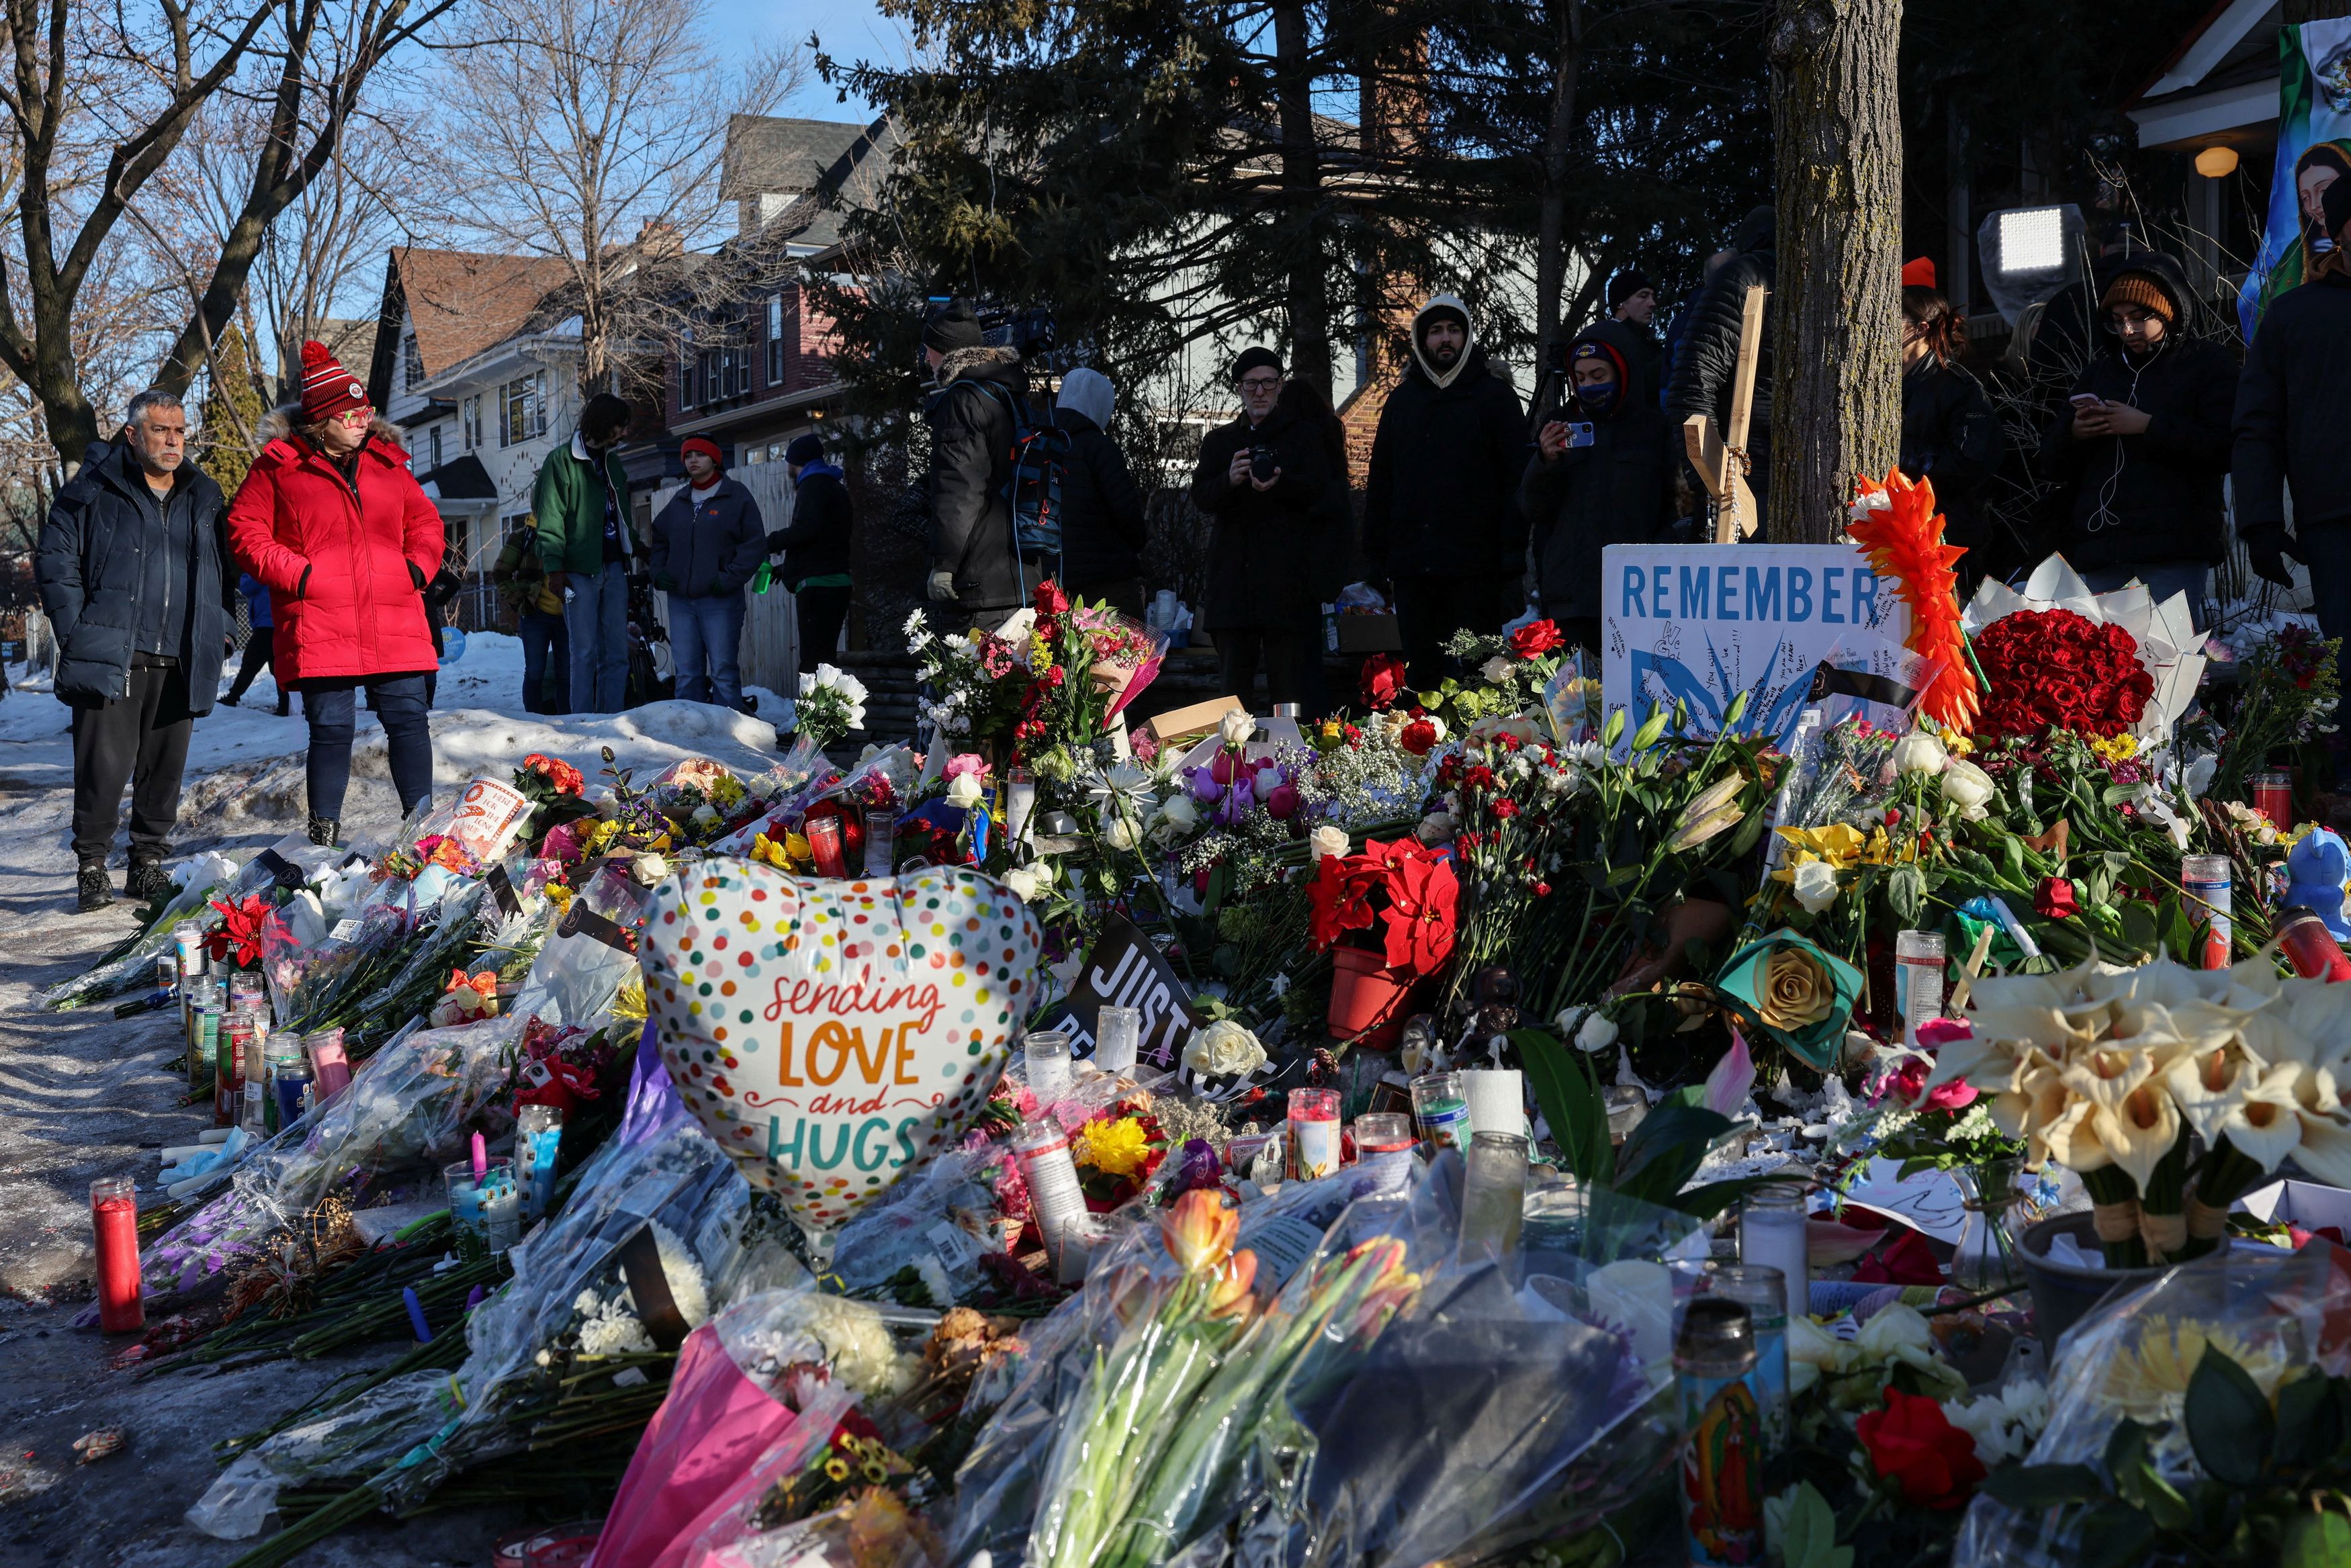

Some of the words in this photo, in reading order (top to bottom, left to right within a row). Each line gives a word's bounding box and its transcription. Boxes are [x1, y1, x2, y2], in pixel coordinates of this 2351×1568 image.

[1622, 565, 1879, 625] REMEMBER
[1607, 616, 1617, 631] REST
[1615, 630, 1625, 643] EASY
[1662, 620, 1681, 649] We
[1722, 647, 1728, 658] be
[1768, 686, 1777, 702] will
[1689, 702, 1703, 716] YOU
[1708, 710, 1724, 721] WI
[1746, 698, 1756, 714] will
[1687, 714, 1695, 727] BE
[483, 798, 498, 810] FOR
[492, 793, 513, 806] HERE
[474, 817, 494, 833] LONG
[486, 811, 500, 823] THE
[763, 964, 946, 1034] sending
[779, 1020, 926, 1087] LOVE
[808, 1085, 888, 1115] and
[766, 1115, 921, 1172] HUGS
